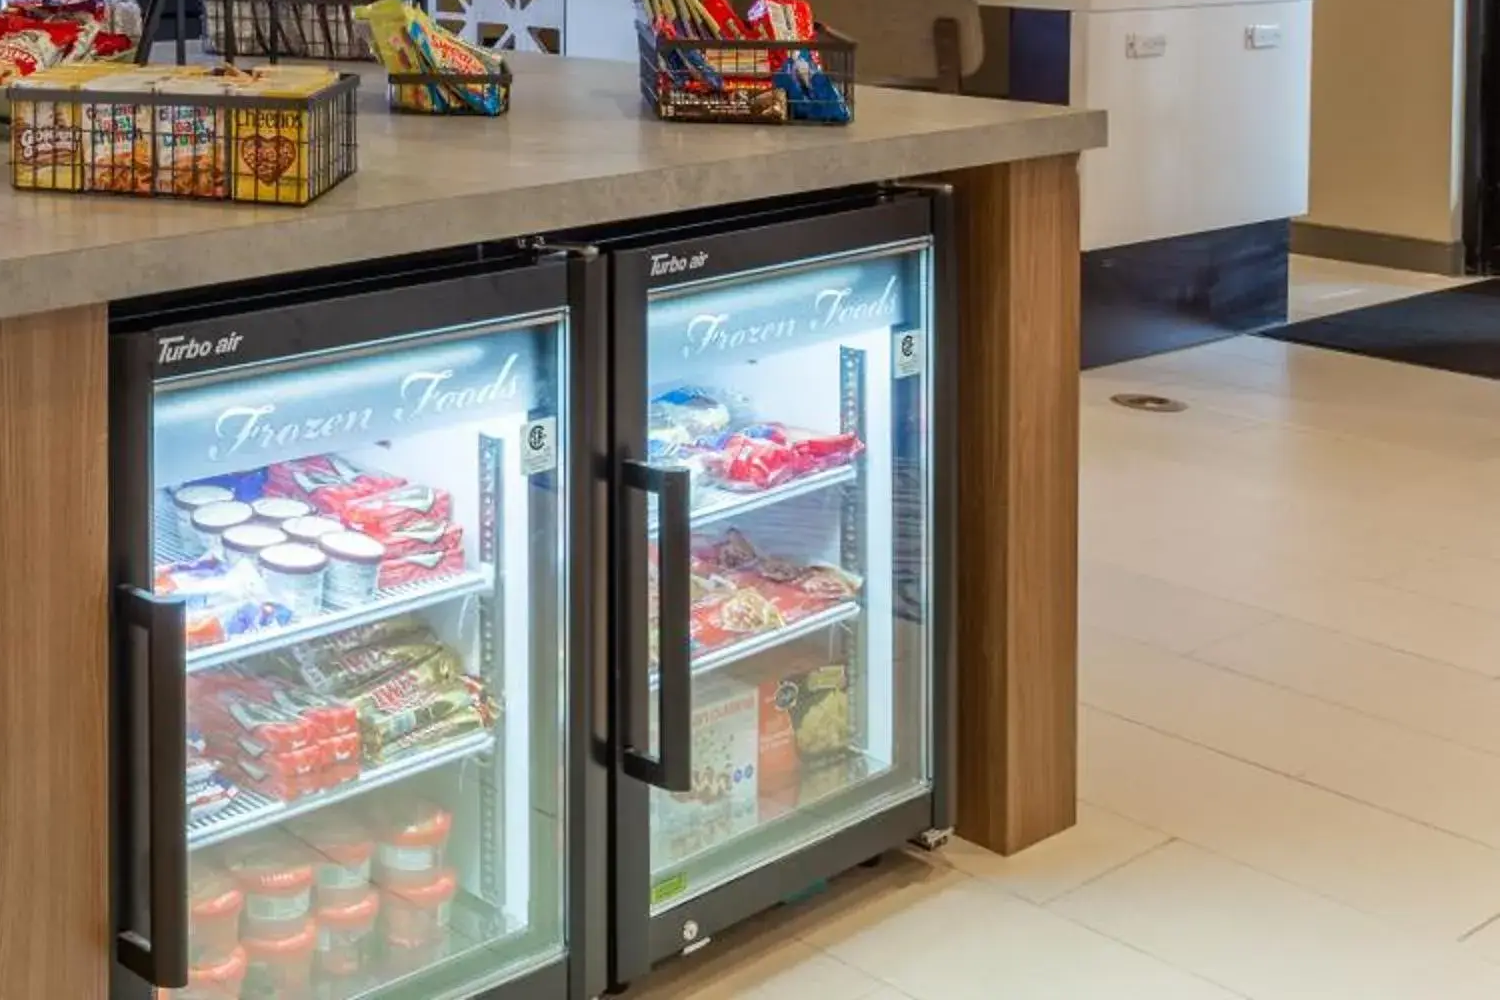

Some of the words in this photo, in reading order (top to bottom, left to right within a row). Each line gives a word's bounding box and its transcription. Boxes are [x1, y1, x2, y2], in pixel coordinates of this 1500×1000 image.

[650, 253, 687, 277] Turbo
[689, 251, 709, 269] air
[682, 313, 796, 359] Frozen
[809, 275, 898, 331] Foods
[158, 335, 213, 365] Turbo
[215, 331, 244, 355] air
[208, 403, 373, 461] Frozen
[393, 352, 519, 424] Foods
